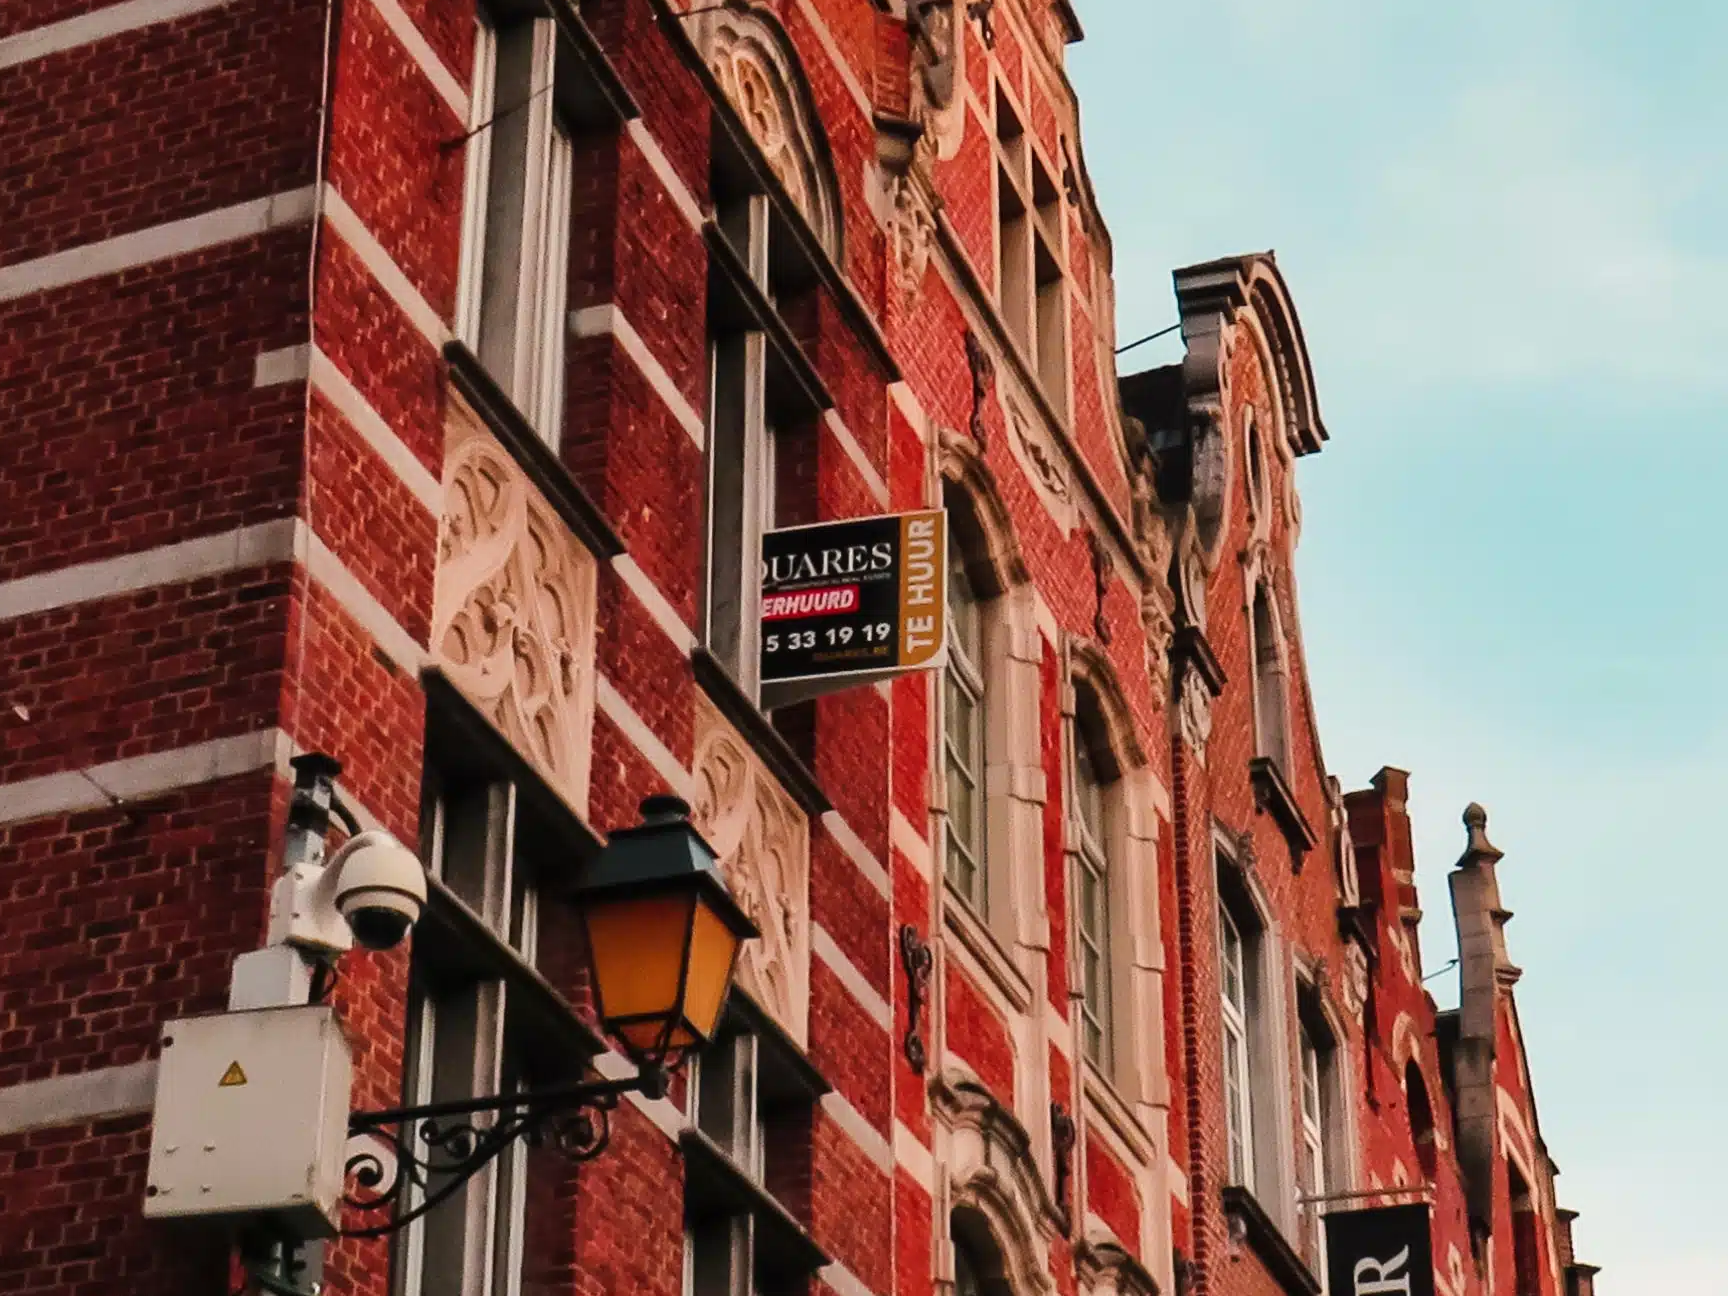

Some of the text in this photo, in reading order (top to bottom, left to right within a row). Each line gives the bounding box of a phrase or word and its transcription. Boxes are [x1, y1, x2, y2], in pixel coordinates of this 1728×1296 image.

[906, 517, 935, 653] TE HUUR
[762, 589, 855, 618] ERHUURD
[787, 630, 816, 649] 33
[825, 627, 854, 646] 19
[862, 622, 891, 642] 19
